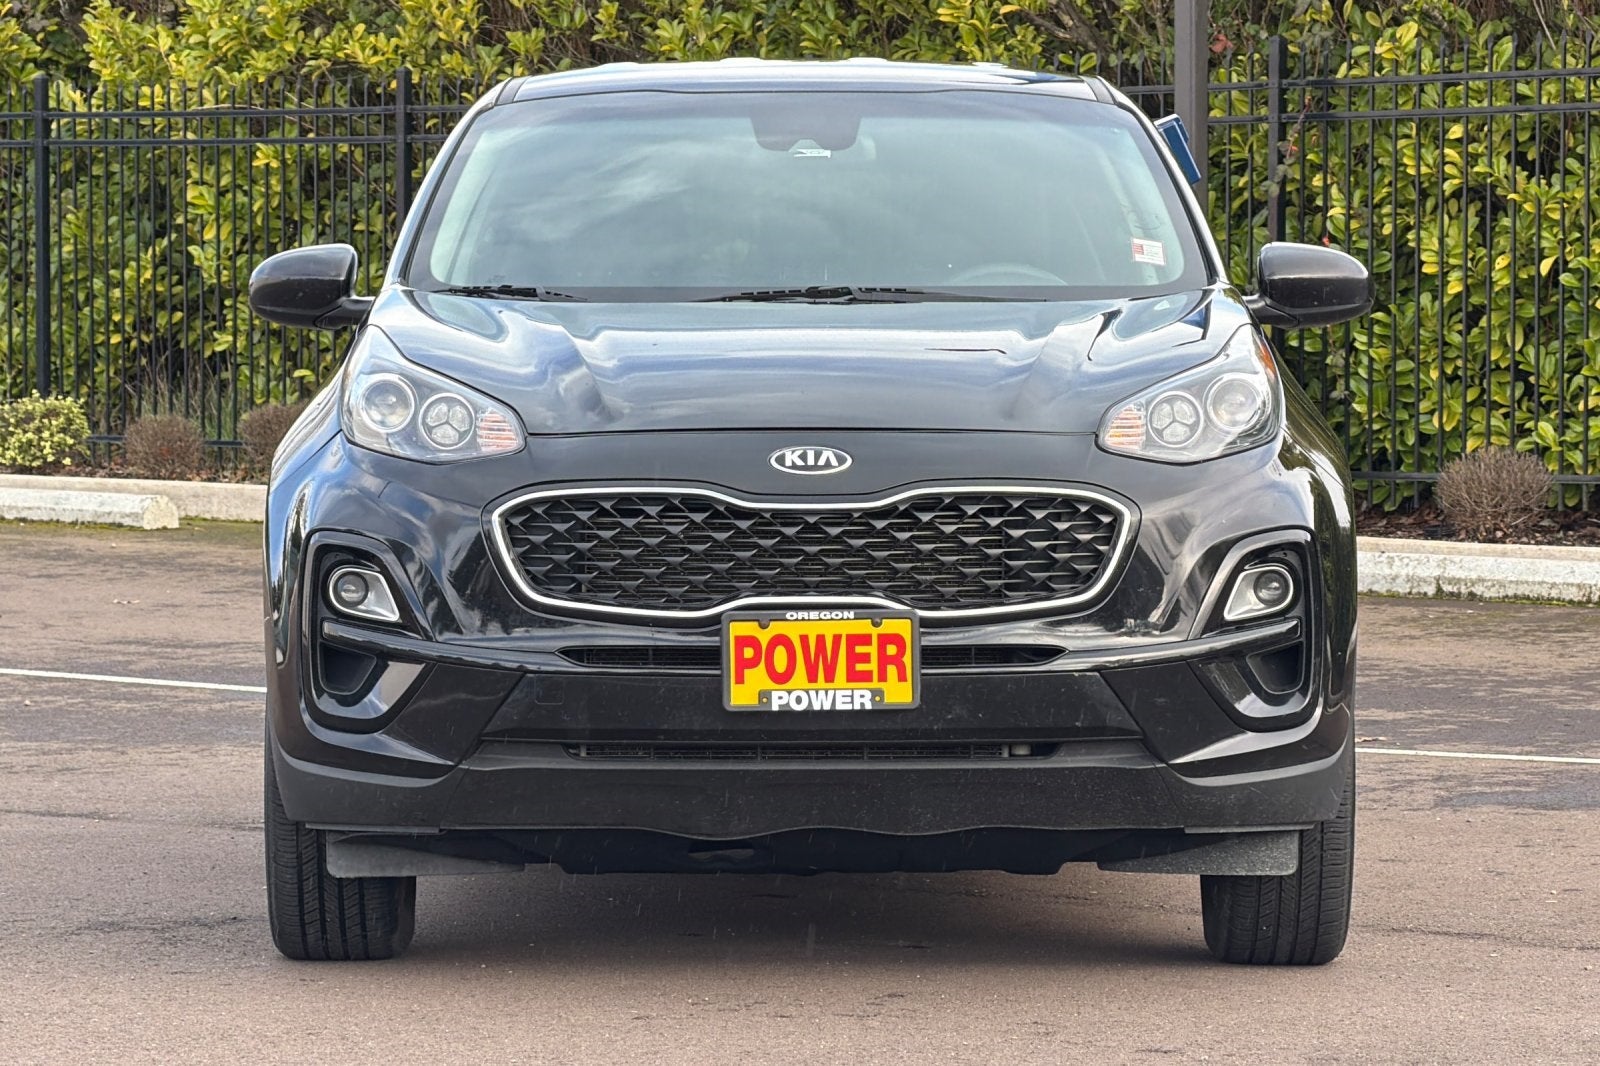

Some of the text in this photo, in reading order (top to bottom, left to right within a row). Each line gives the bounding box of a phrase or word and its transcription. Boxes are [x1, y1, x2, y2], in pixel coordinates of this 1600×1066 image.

[784, 450, 838, 466] KIA
[785, 611, 854, 620] OREGON
[734, 633, 908, 685] POWER
[772, 689, 872, 711] POWER
